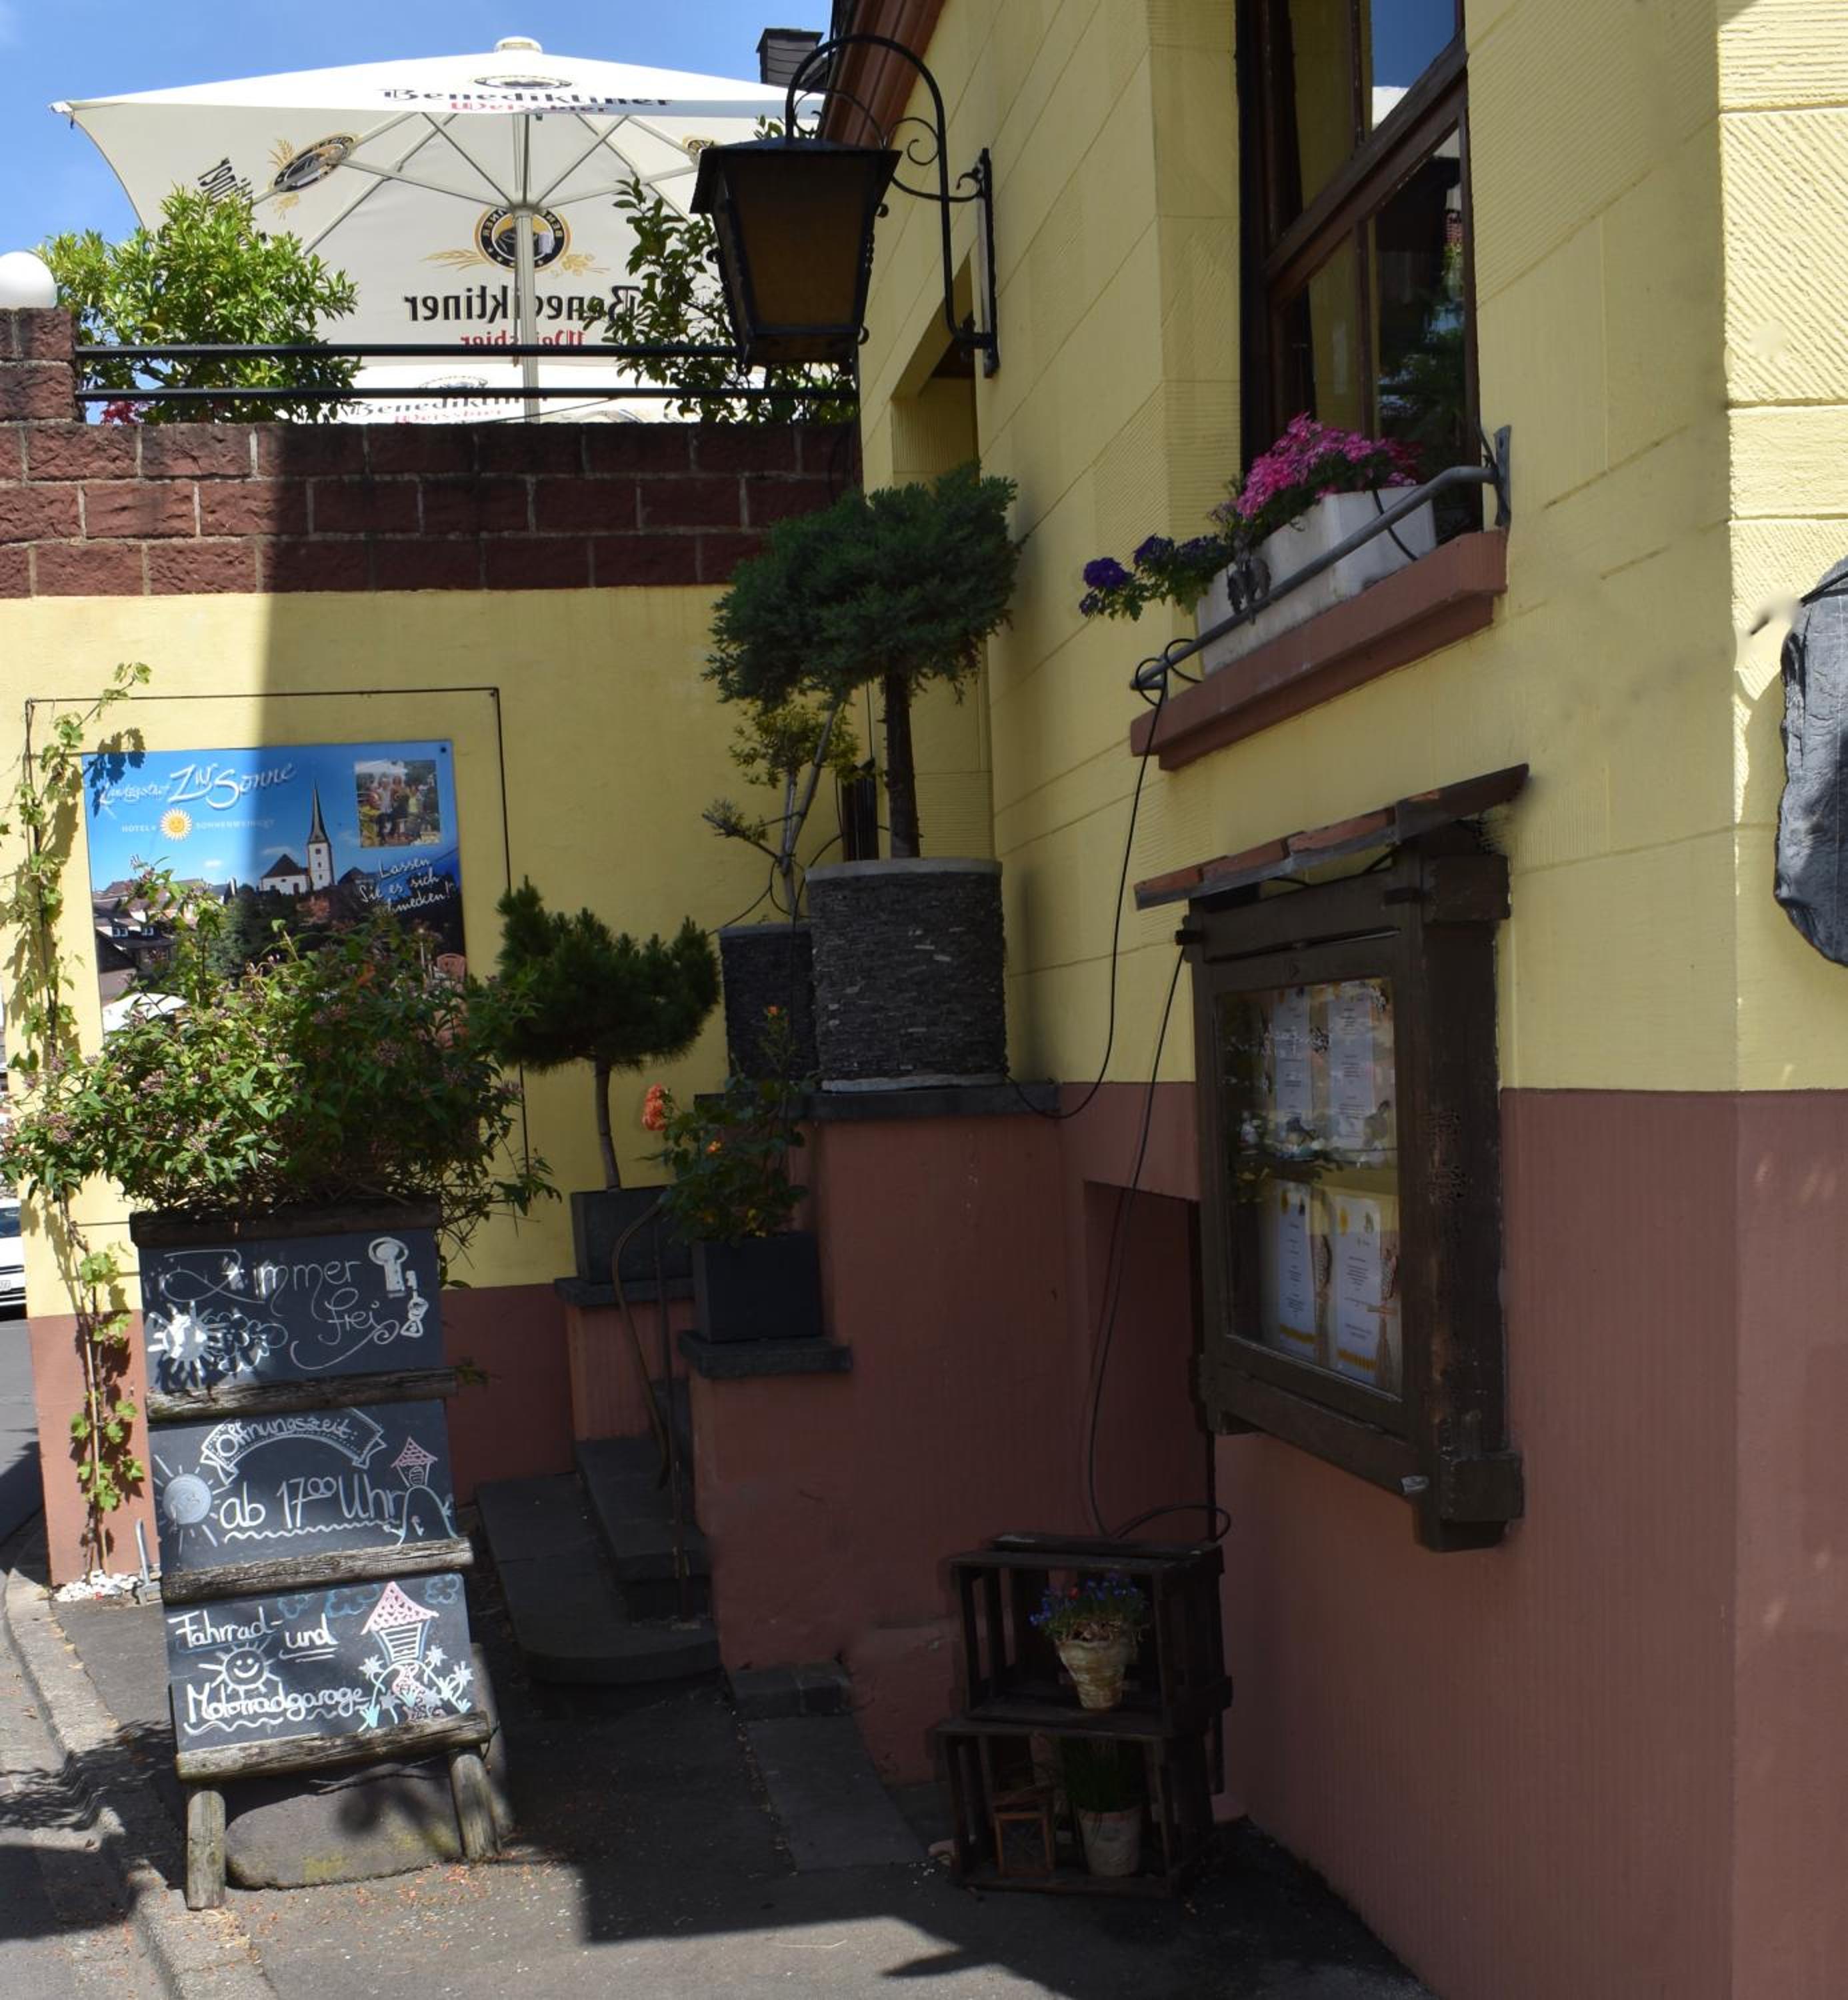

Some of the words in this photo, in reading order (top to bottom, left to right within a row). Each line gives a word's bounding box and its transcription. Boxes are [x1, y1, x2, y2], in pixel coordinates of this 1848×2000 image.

[359, 884, 383, 903] Sie
[389, 883, 404, 894] es
[410, 867, 439, 887] sich
[378, 857, 431, 879] Lassen
[219, 1481, 266, 1529] ab
[339, 1473, 407, 1519] Uhr
[285, 1613, 339, 1649] und
[186, 1681, 371, 1723] Motorradgarage
